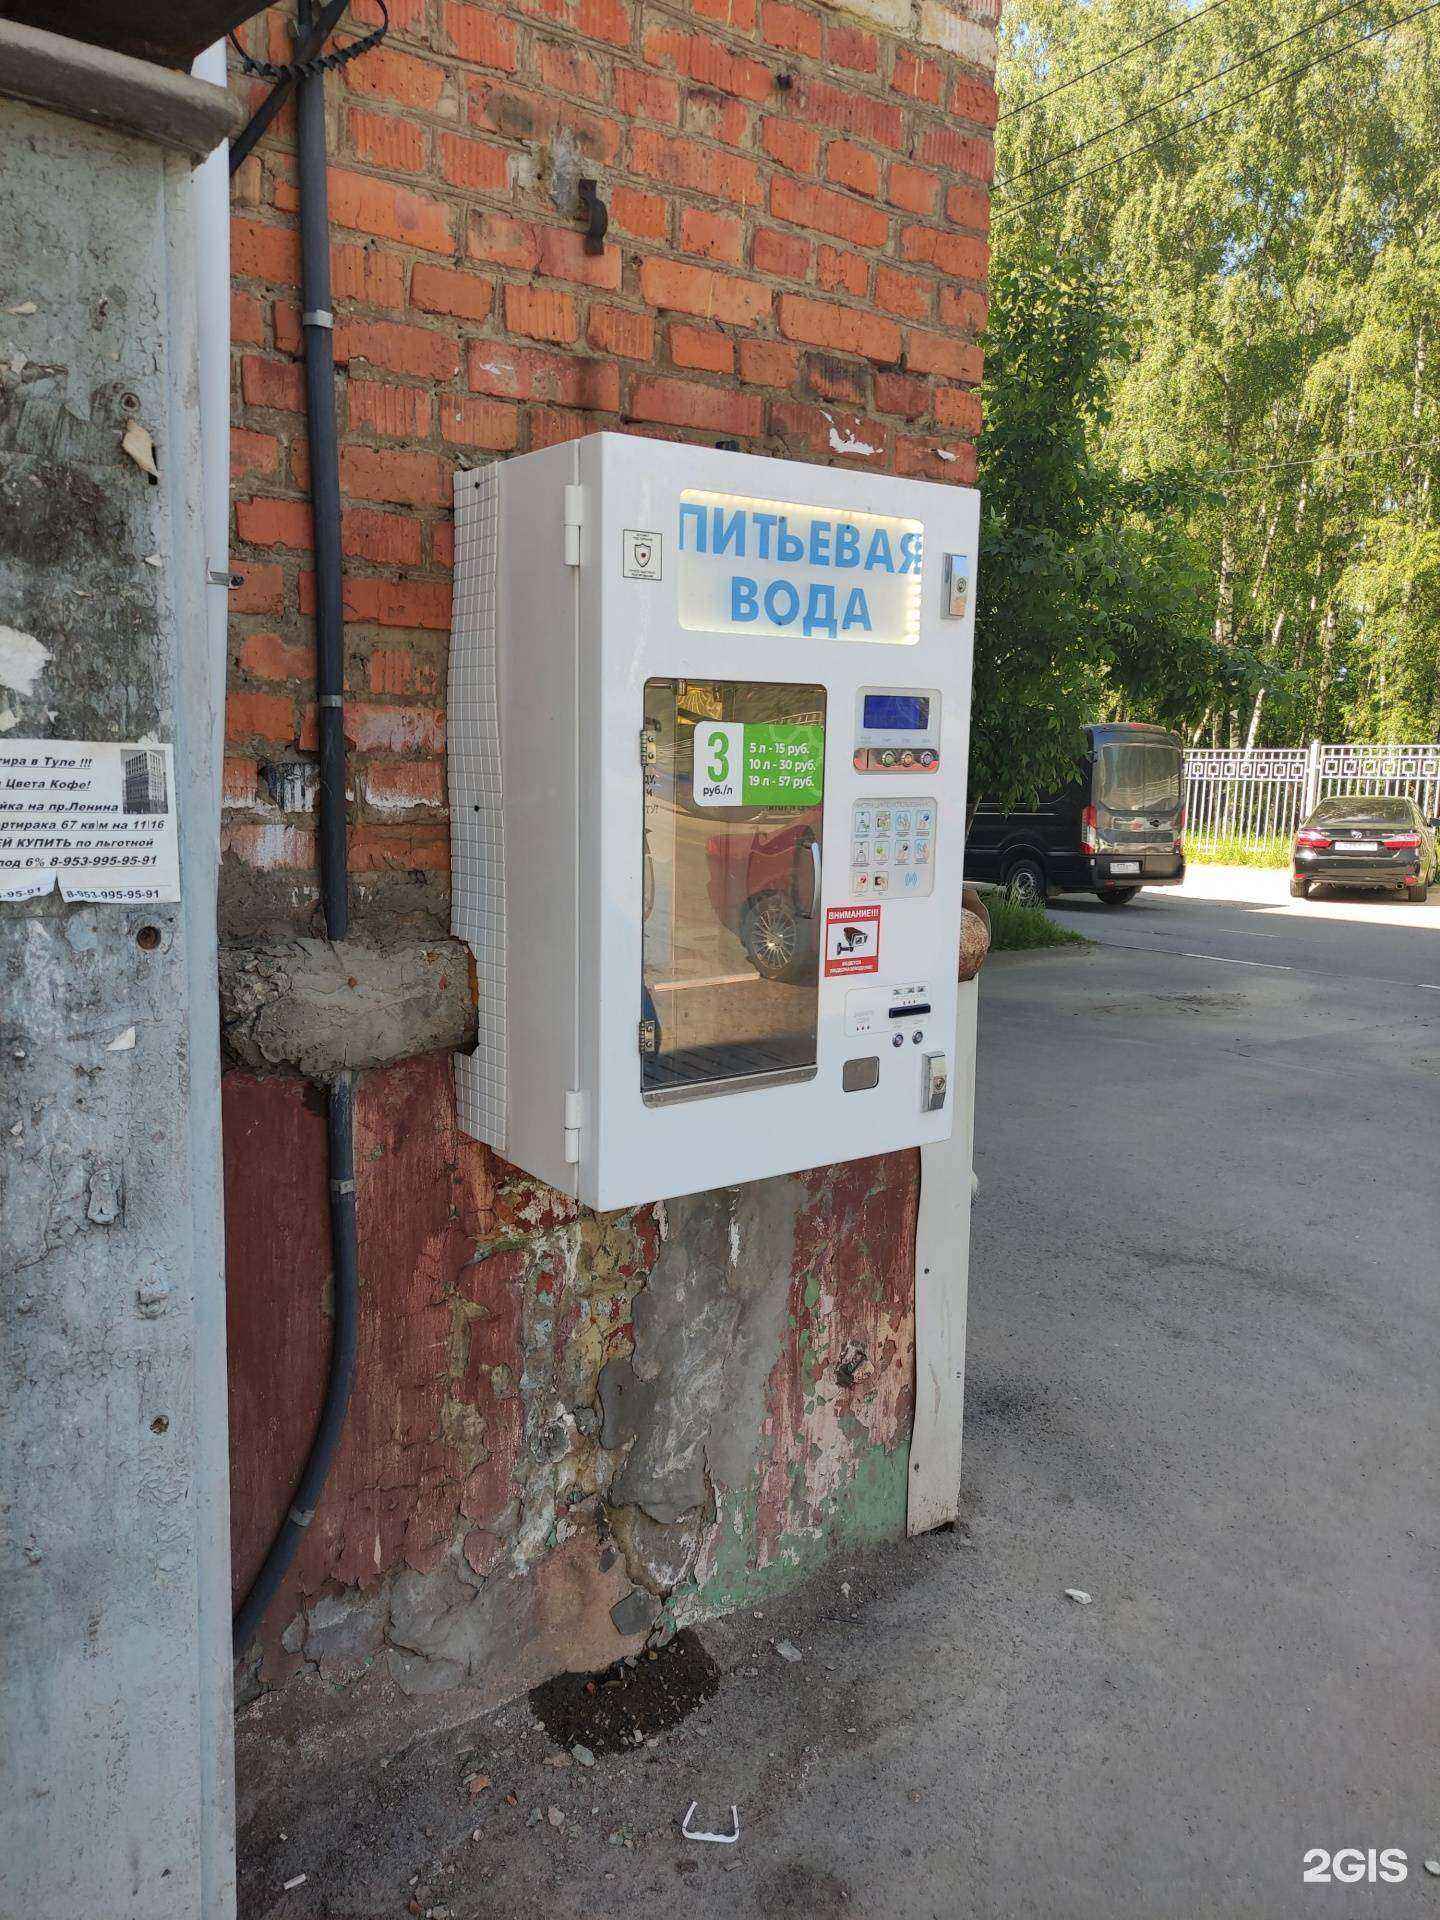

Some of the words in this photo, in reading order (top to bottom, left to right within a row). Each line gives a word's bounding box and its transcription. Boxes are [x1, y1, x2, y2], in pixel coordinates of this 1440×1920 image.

[679, 502, 922, 575] ПИТЬЕВАЯ
[731, 576, 872, 639] ВОДА
[749, 742, 758, 754] 5
[759, 743, 767, 754] л
[775, 742, 786, 754] 15
[788, 742, 811, 756] руб.
[80, 758, 93, 768] !!!
[707, 731, 729, 783] 3
[749, 759, 761, 770] 10
[763, 761, 771, 770] л
[780, 759, 793, 770] 30
[795, 760, 816, 773] руб.
[6, 779, 45, 790] Цвета
[50, 780, 92, 791] Кофе!
[749, 775, 761, 786] 19
[762, 777, 770, 786] л
[778, 776, 791, 787] 57
[793, 776, 815, 789] руб.
[703, 784, 733, 797] руб./л
[28, 803, 44, 811] на
[61, 820, 78, 829] 67
[112, 822, 128, 830] на
[17, 838, 71, 848] КУПИТЬ
[76, 840, 92, 848] по
[95, 838, 154, 848] льготной
[26, 857, 45, 867] 6%
[49, 855, 157, 867] 8-953-995-95-91
[0, 887, 41, 899] -95-91
[66, 890, 159, 899] 8-953-995-95-91
